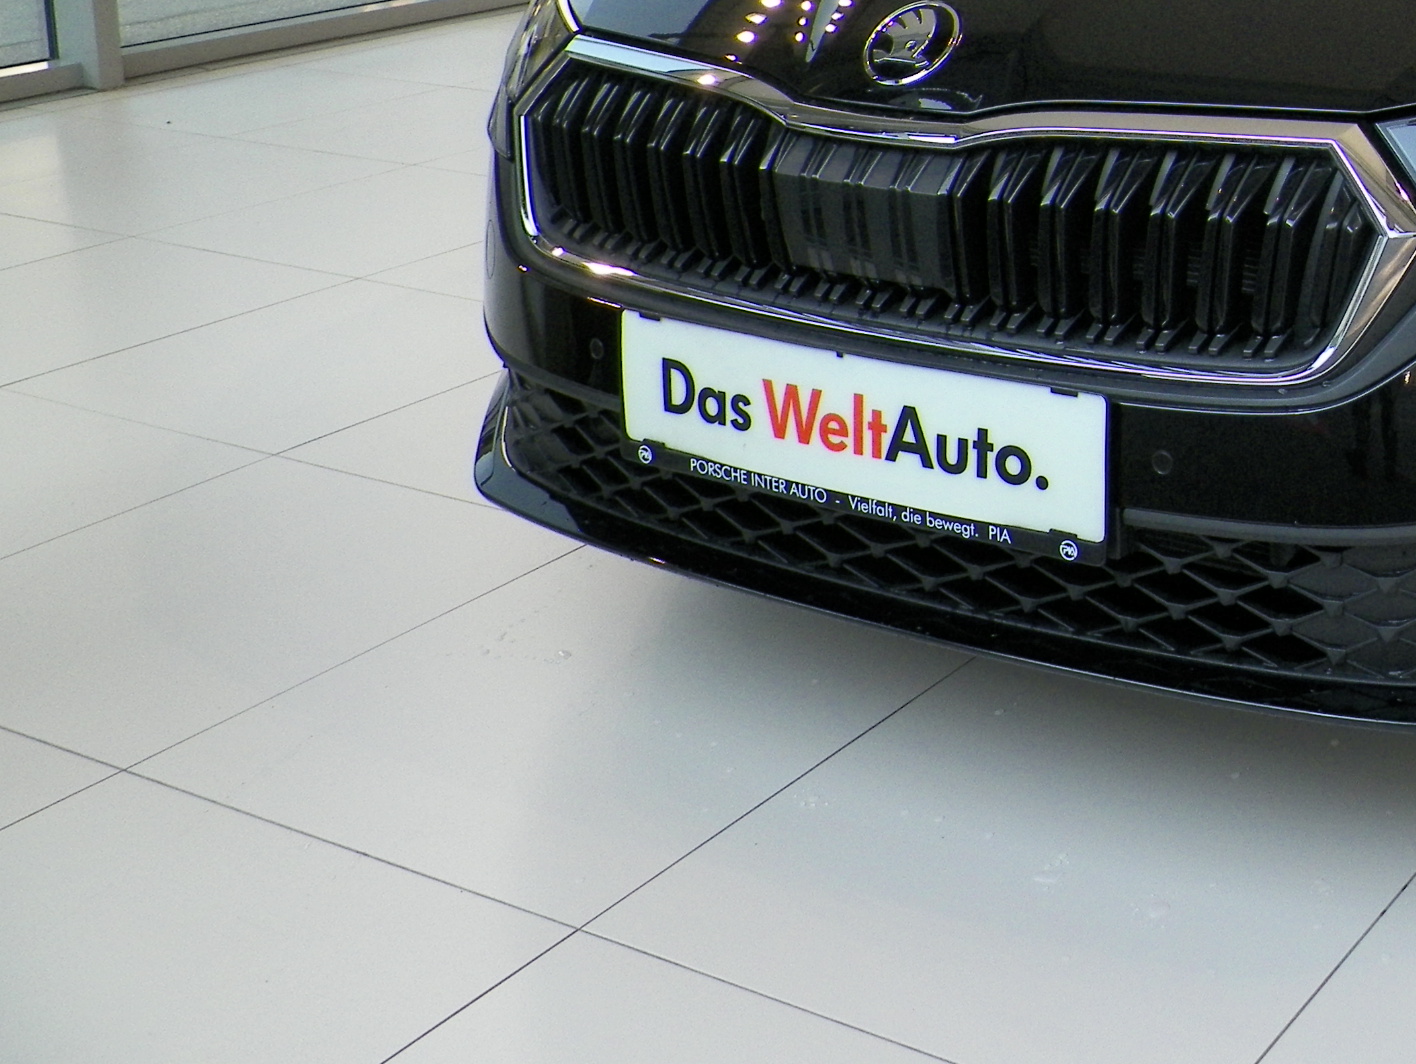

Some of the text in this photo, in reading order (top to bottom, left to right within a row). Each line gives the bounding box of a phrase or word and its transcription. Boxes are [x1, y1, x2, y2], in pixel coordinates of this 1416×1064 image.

[662, 358, 1049, 491] Das WeltAuto.
[690, 458, 748, 484] PORSCHE
[751, 473, 787, 494] INTER
[790, 484, 827, 503] AUTO
[848, 495, 897, 521] Vielfalt,
[901, 507, 922, 525] die
[926, 512, 979, 538] bewegt.
[988, 525, 1011, 544] PIA
